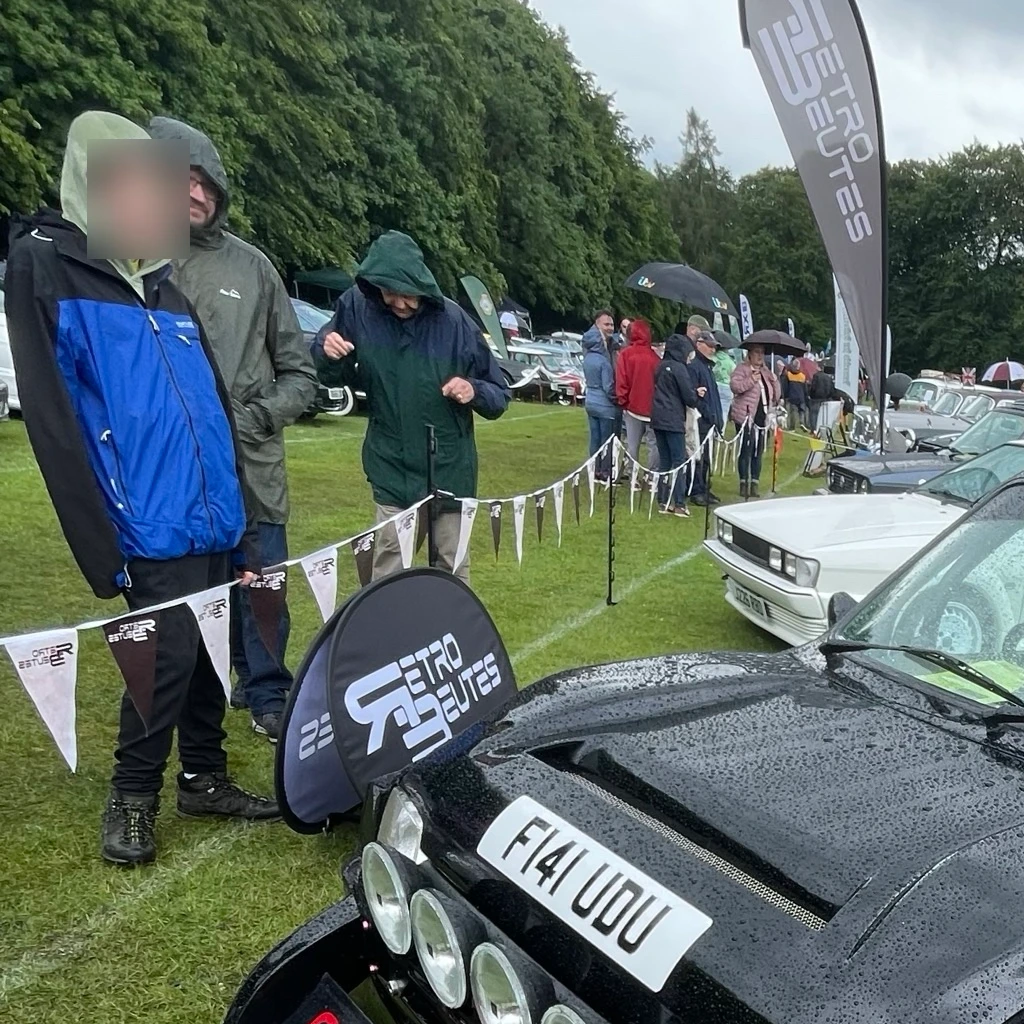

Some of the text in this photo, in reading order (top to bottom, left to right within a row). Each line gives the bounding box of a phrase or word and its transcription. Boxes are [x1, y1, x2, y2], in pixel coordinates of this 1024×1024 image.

[344, 633, 463, 755] RETRO
[393, 652, 501, 762] BEUTES
[501, 815, 673, 955] F141 UDU
